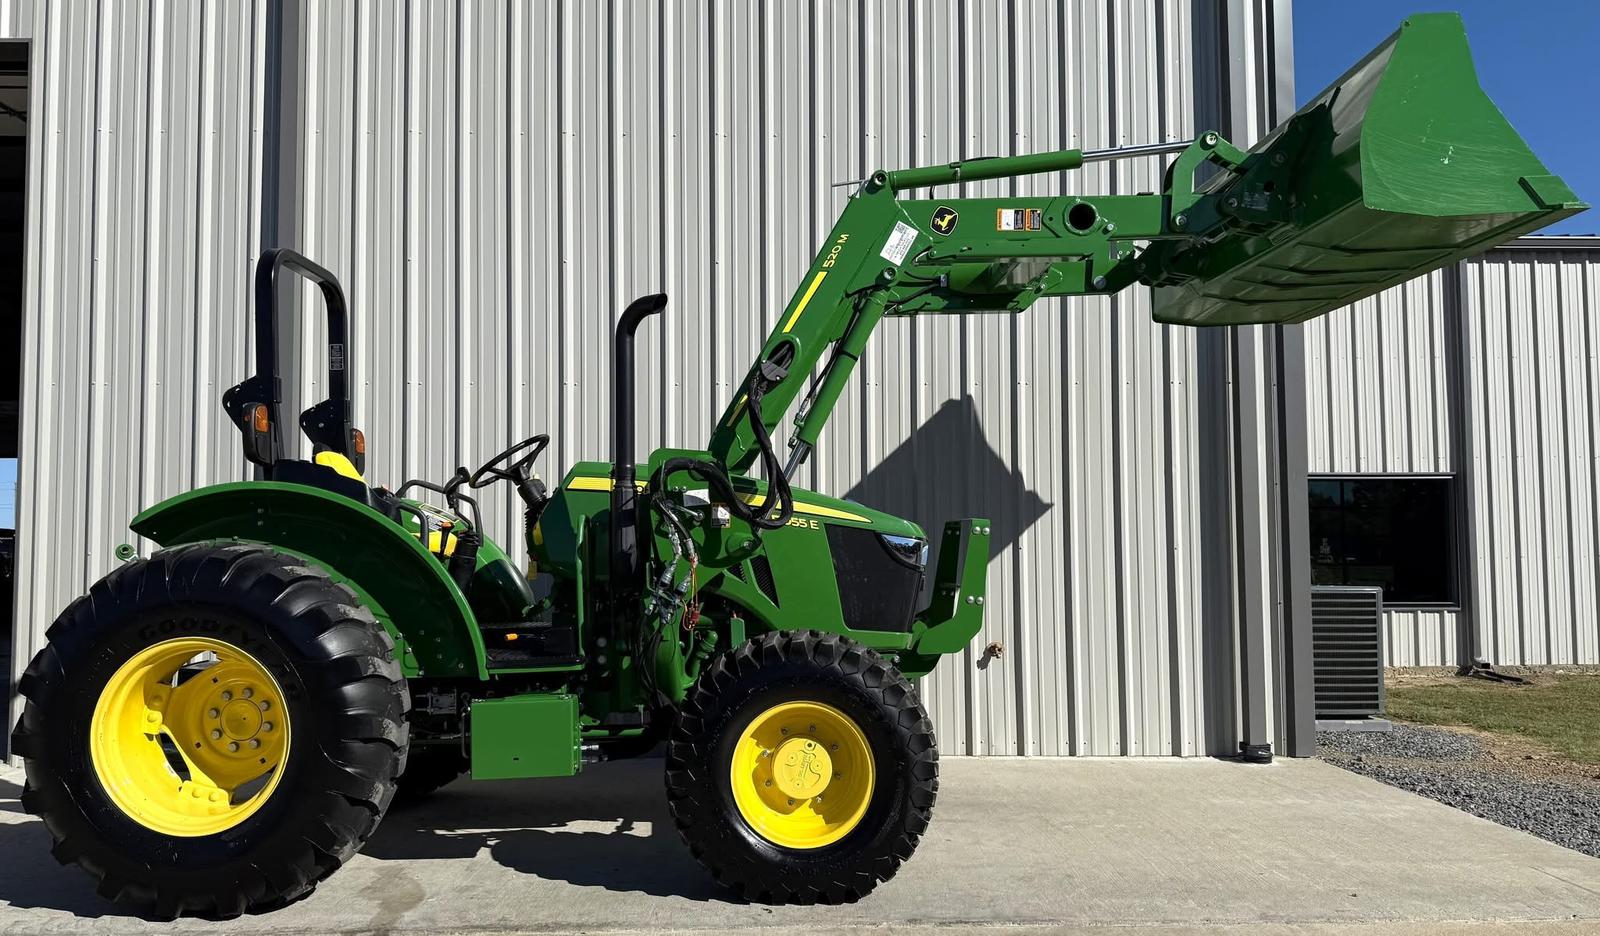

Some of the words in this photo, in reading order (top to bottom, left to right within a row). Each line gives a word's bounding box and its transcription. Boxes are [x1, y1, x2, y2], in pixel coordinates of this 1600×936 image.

[822, 245, 842, 268] 520
[836, 234, 850, 243] M
[809, 519, 820, 530] E
